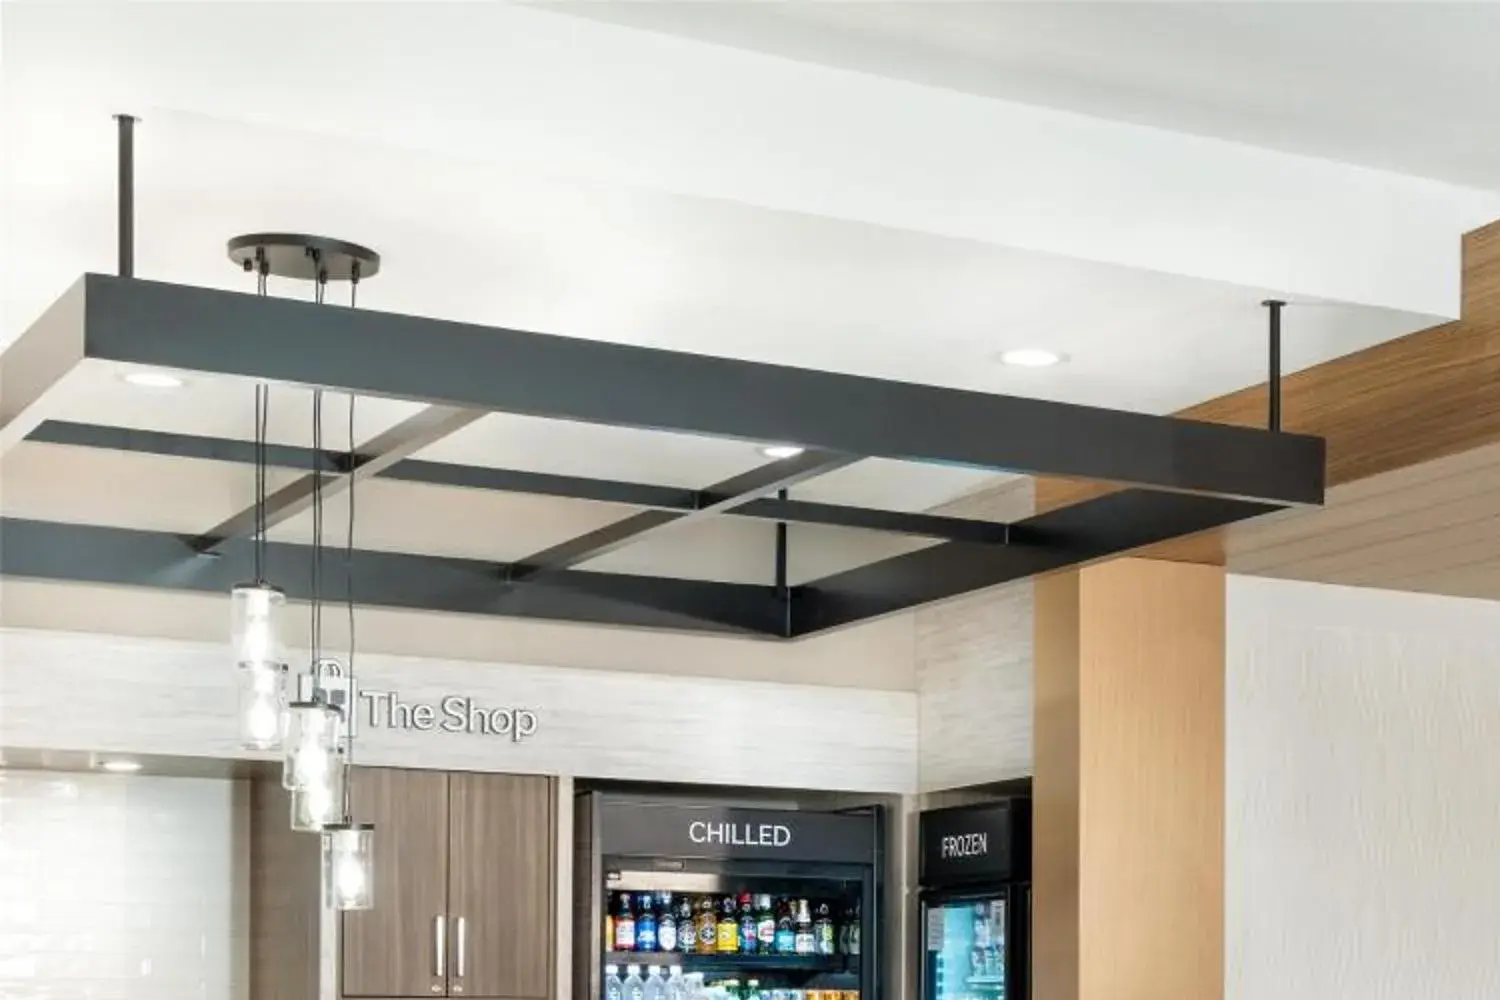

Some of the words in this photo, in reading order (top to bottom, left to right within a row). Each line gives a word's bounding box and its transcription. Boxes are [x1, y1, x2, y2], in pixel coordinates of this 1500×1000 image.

[359, 690, 435, 730] The
[438, 695, 538, 742] Shop
[688, 821, 791, 847] CHILLED
[941, 832, 987, 858] FROZEN
